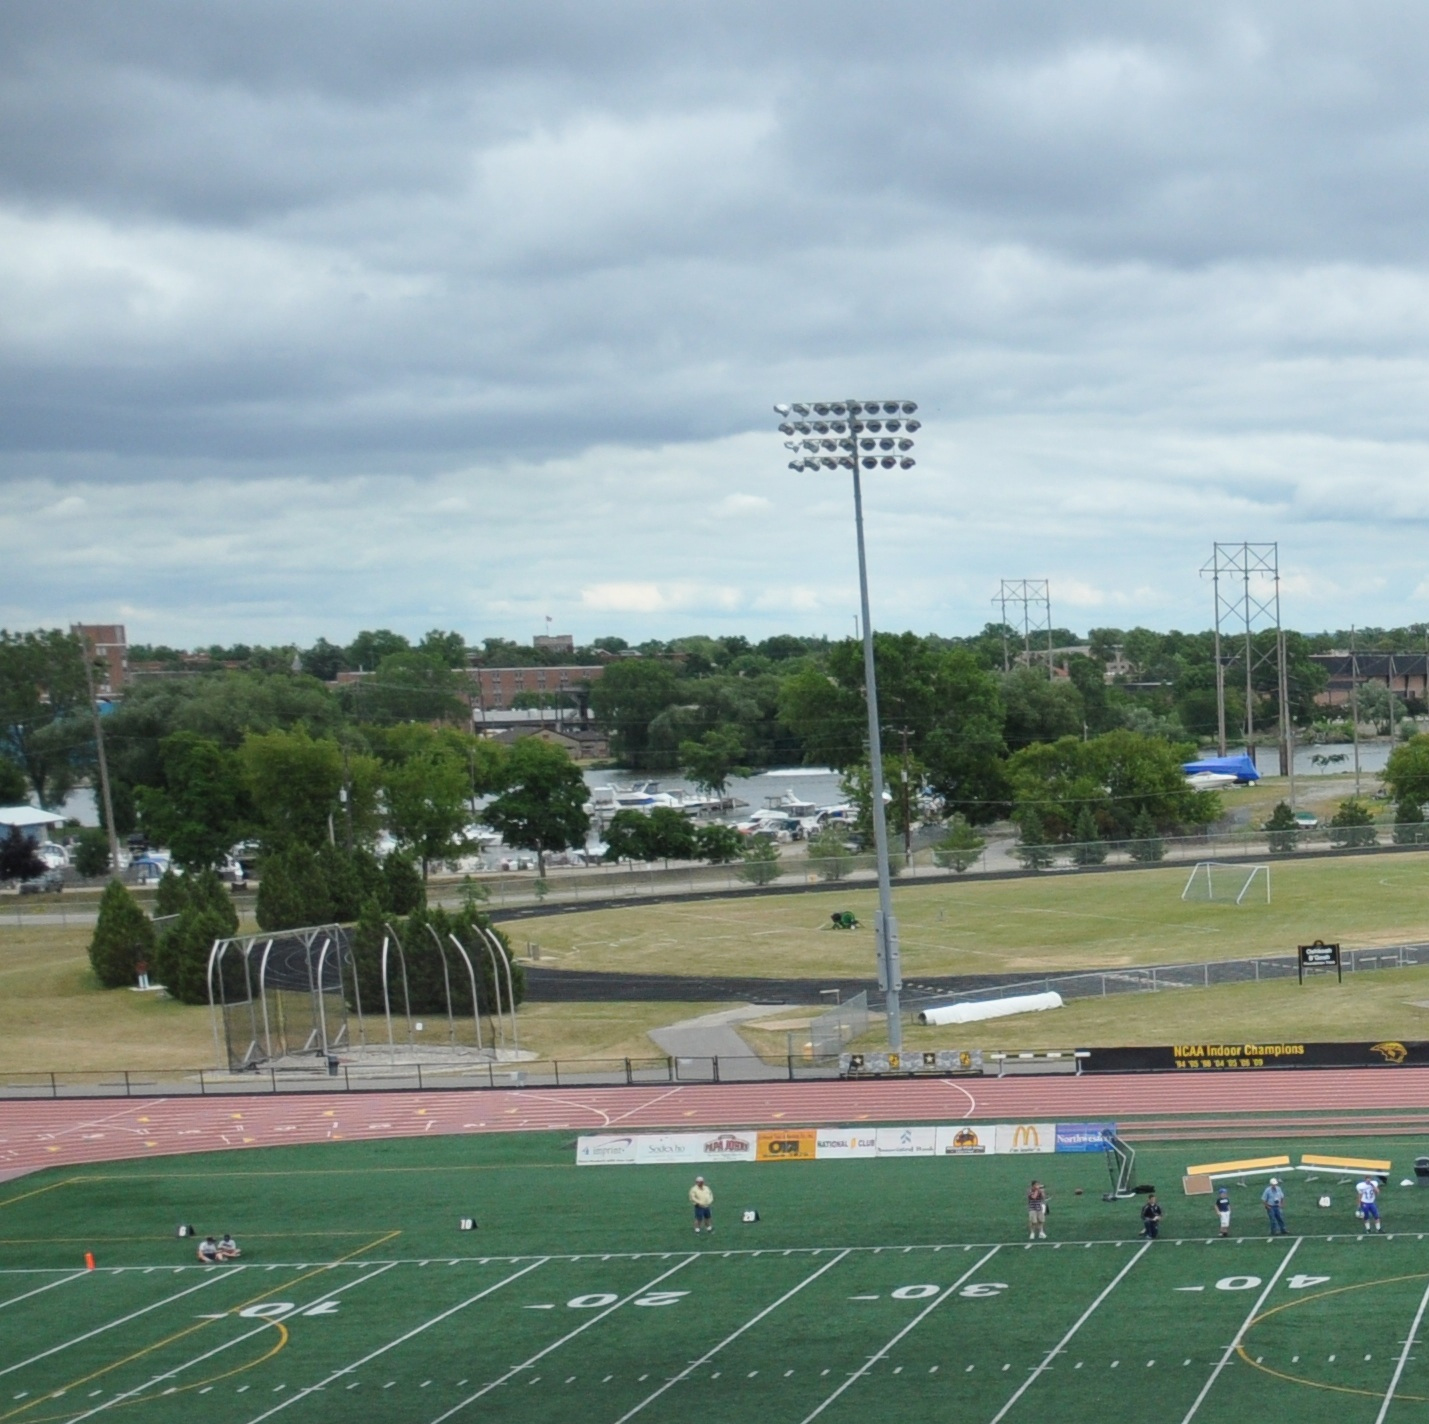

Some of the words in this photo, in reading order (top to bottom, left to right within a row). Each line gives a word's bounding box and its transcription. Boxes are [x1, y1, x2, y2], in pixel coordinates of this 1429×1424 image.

[1174, 1044, 1205, 1058] NCAA
[1207, 1044, 1242, 1057] Indoor
[1244, 1043, 1304, 1057] Champions
[818, 1140, 848, 1148] NATIONAL
[858, 1139, 875, 1148] CLUB
[461, 1219, 472, 1230] 10
